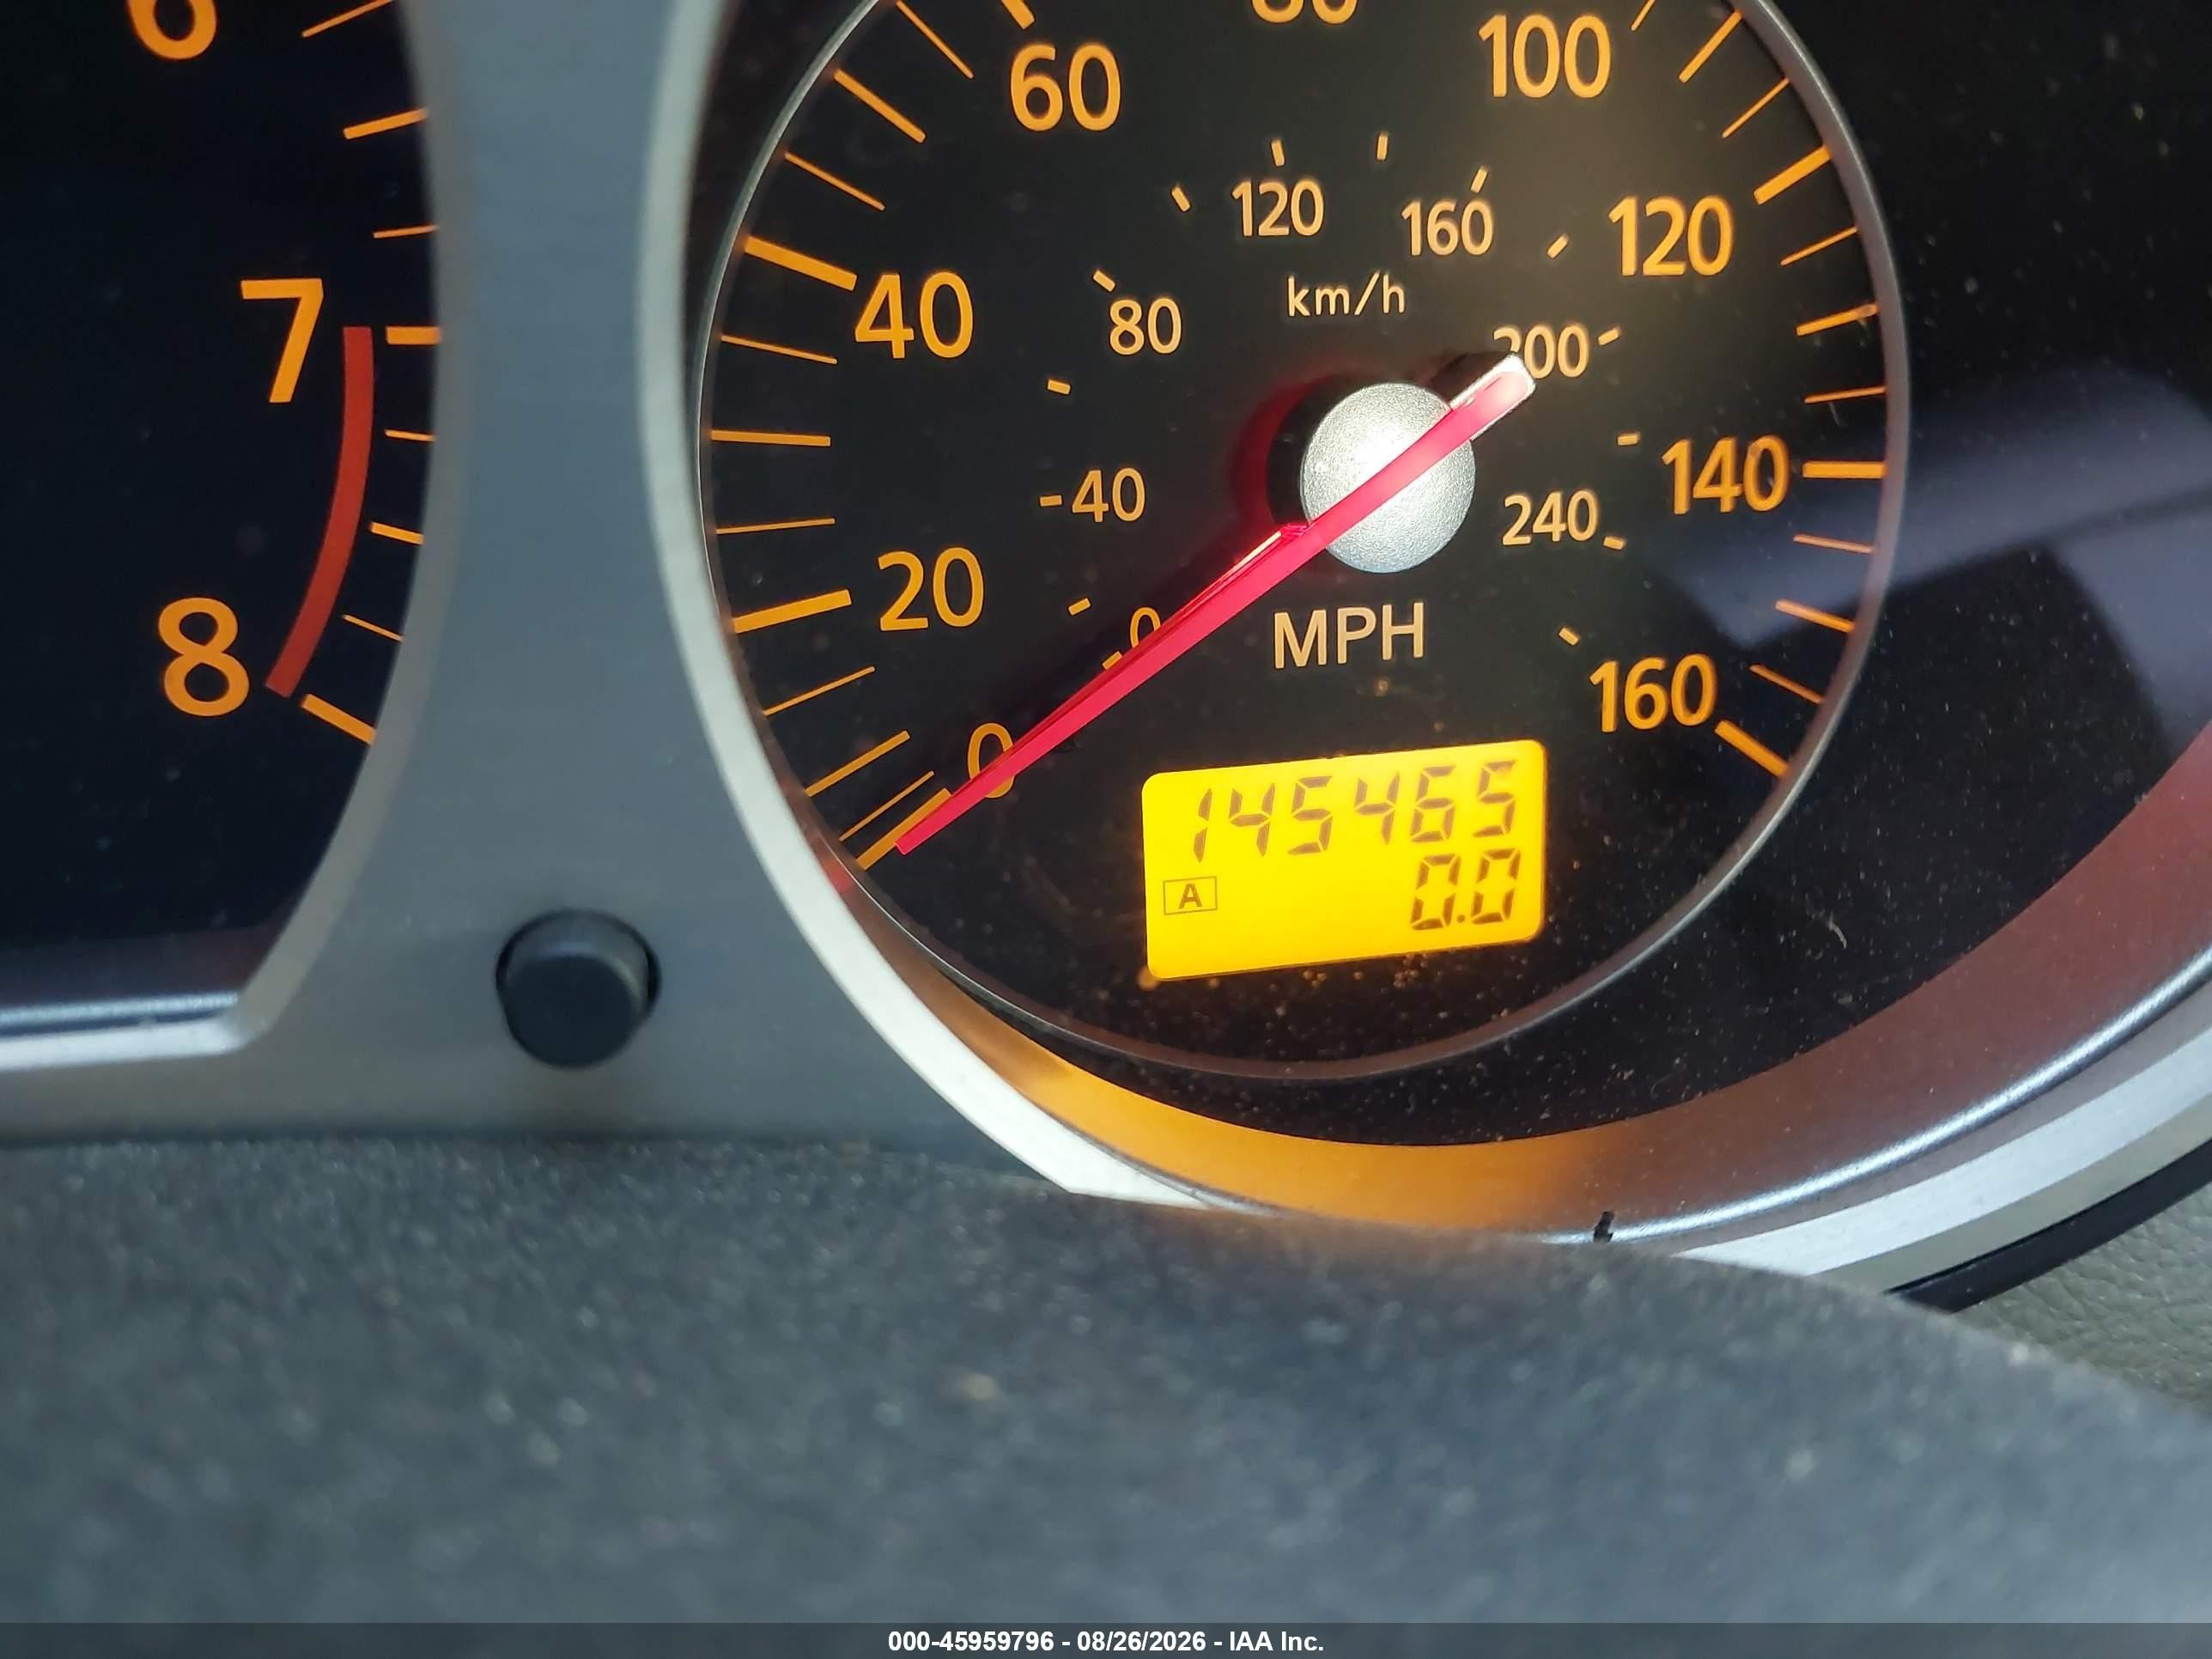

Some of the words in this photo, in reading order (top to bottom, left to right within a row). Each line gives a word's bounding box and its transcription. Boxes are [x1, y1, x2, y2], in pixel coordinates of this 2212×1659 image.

[1010, 43, 1121, 131] 60
[1478, 15, 1611, 99] 100
[1232, 179, 1324, 236] 120
[1402, 199, 1493, 256] 160
[1609, 196, 1734, 276] 120
[854, 272, 974, 359] 40
[1109, 297, 1182, 355] 80
[1288, 272, 1407, 317] km/h
[240, 278, 324, 402] 7
[1072, 468, 1146, 522] 40
[1662, 434, 1790, 514] 140
[1502, 489, 1599, 545] 240
[878, 547, 984, 630] 20
[158, 598, 249, 717] 8
[1273, 602, 1425, 669] MPH
[1589, 653, 1716, 732] 160
[1193, 759, 1518, 863] 145465
[1179, 884, 1203, 909] A
[1411, 848, 1521, 931] 0.0
